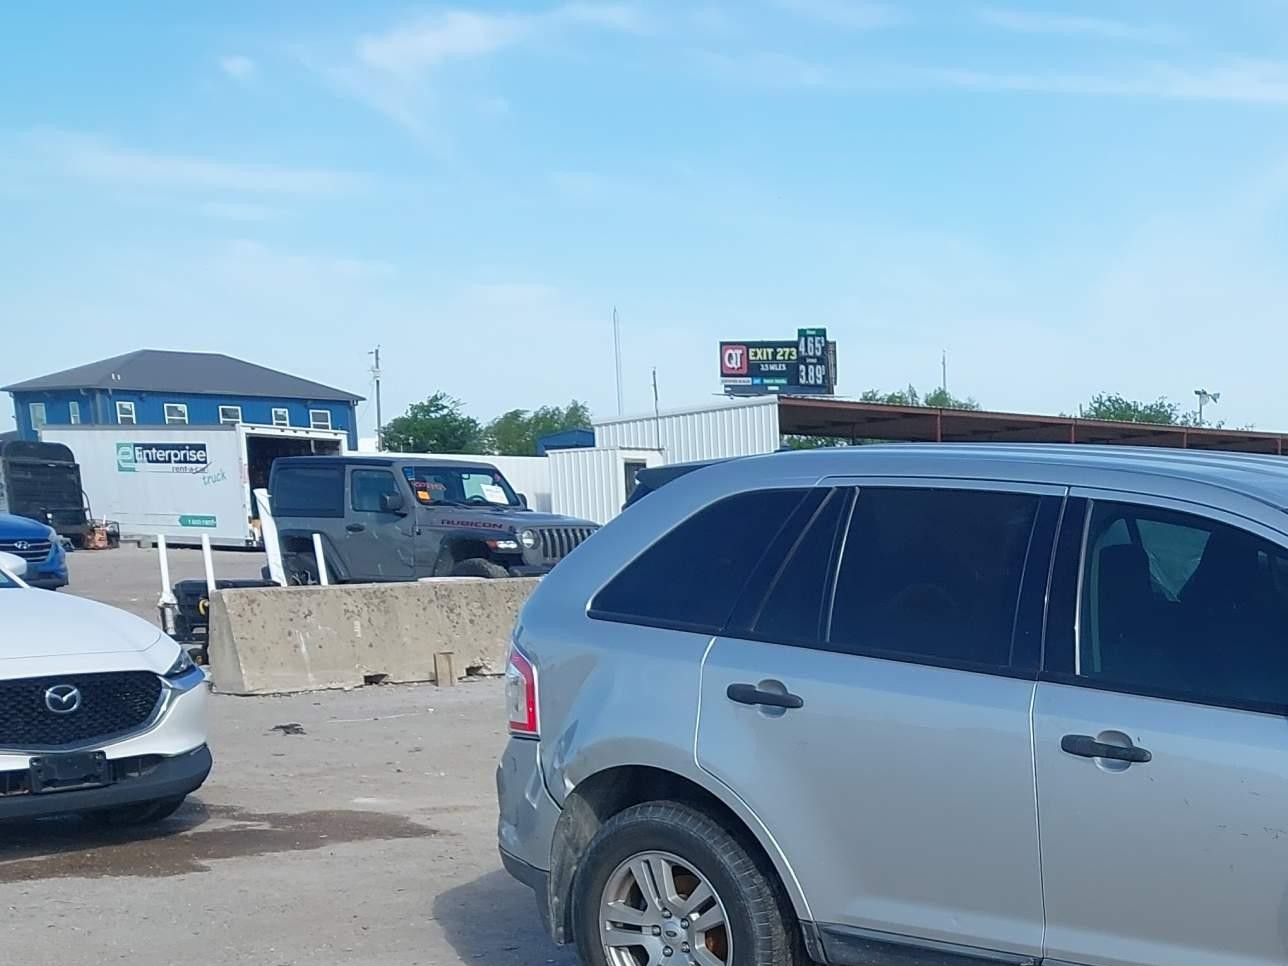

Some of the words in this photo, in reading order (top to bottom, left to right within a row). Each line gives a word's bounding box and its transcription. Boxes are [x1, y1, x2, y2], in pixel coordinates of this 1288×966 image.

[749, 347, 774, 360] EXIT
[776, 347, 798, 360] 273
[135, 446, 206, 464] Enterprise
[440, 519, 504, 529] RUBICON
